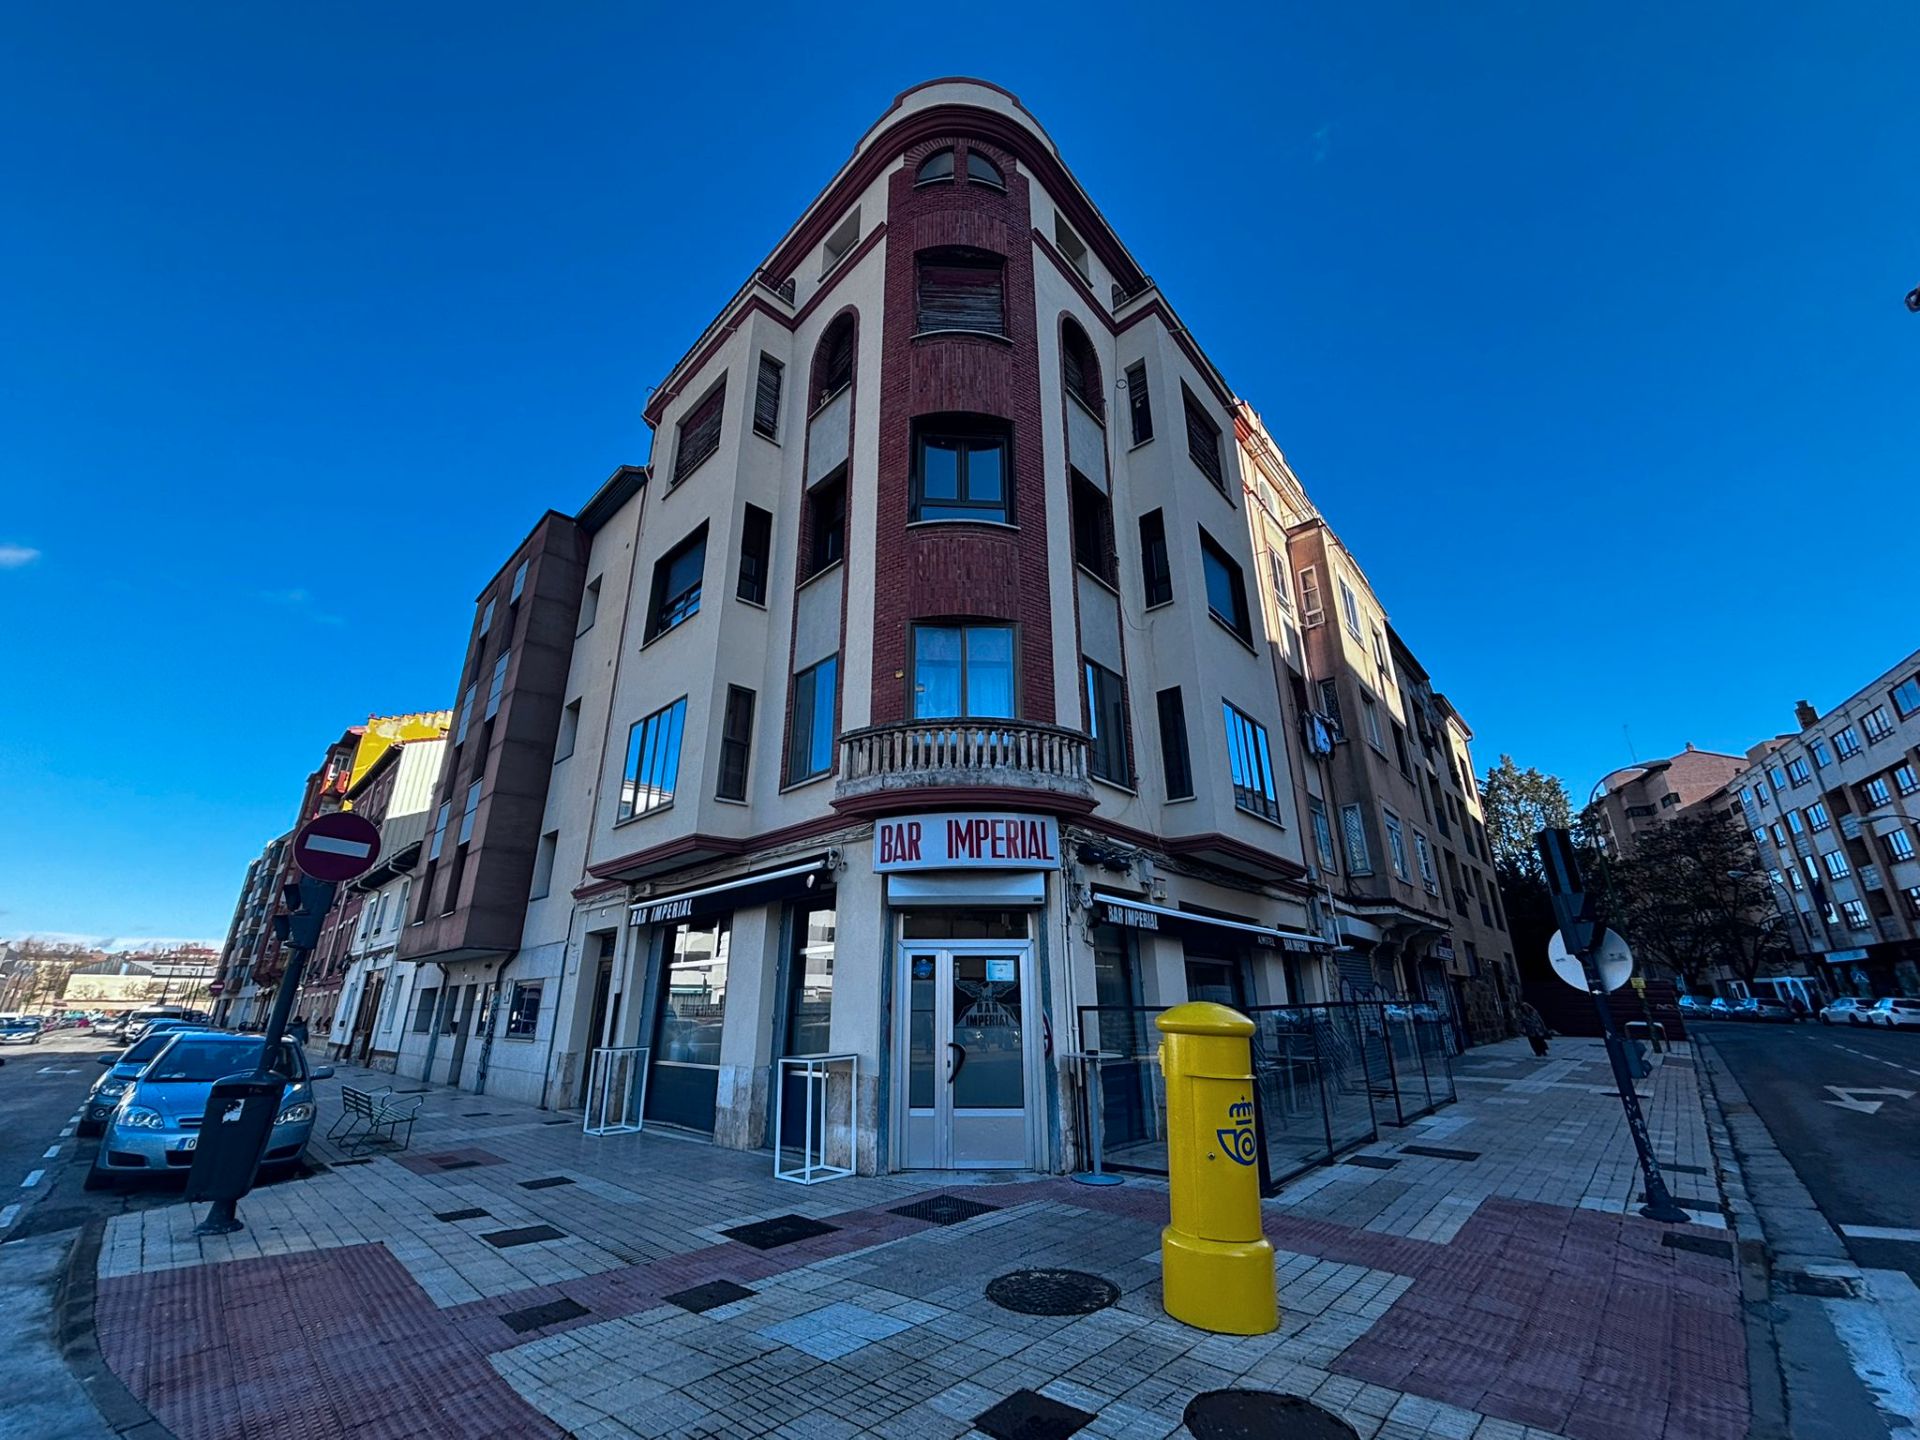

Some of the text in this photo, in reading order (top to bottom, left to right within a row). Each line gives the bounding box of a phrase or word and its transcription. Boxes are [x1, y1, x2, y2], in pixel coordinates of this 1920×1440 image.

[880, 819, 1055, 864] BAR IMPERIAL
[630, 899, 693, 926] BAR IMPERIAL
[1107, 905, 1159, 930] BAR IMPERIAL
[976, 1002, 998, 1013] BAR
[965, 1014, 1010, 1027] IMPERIAL
